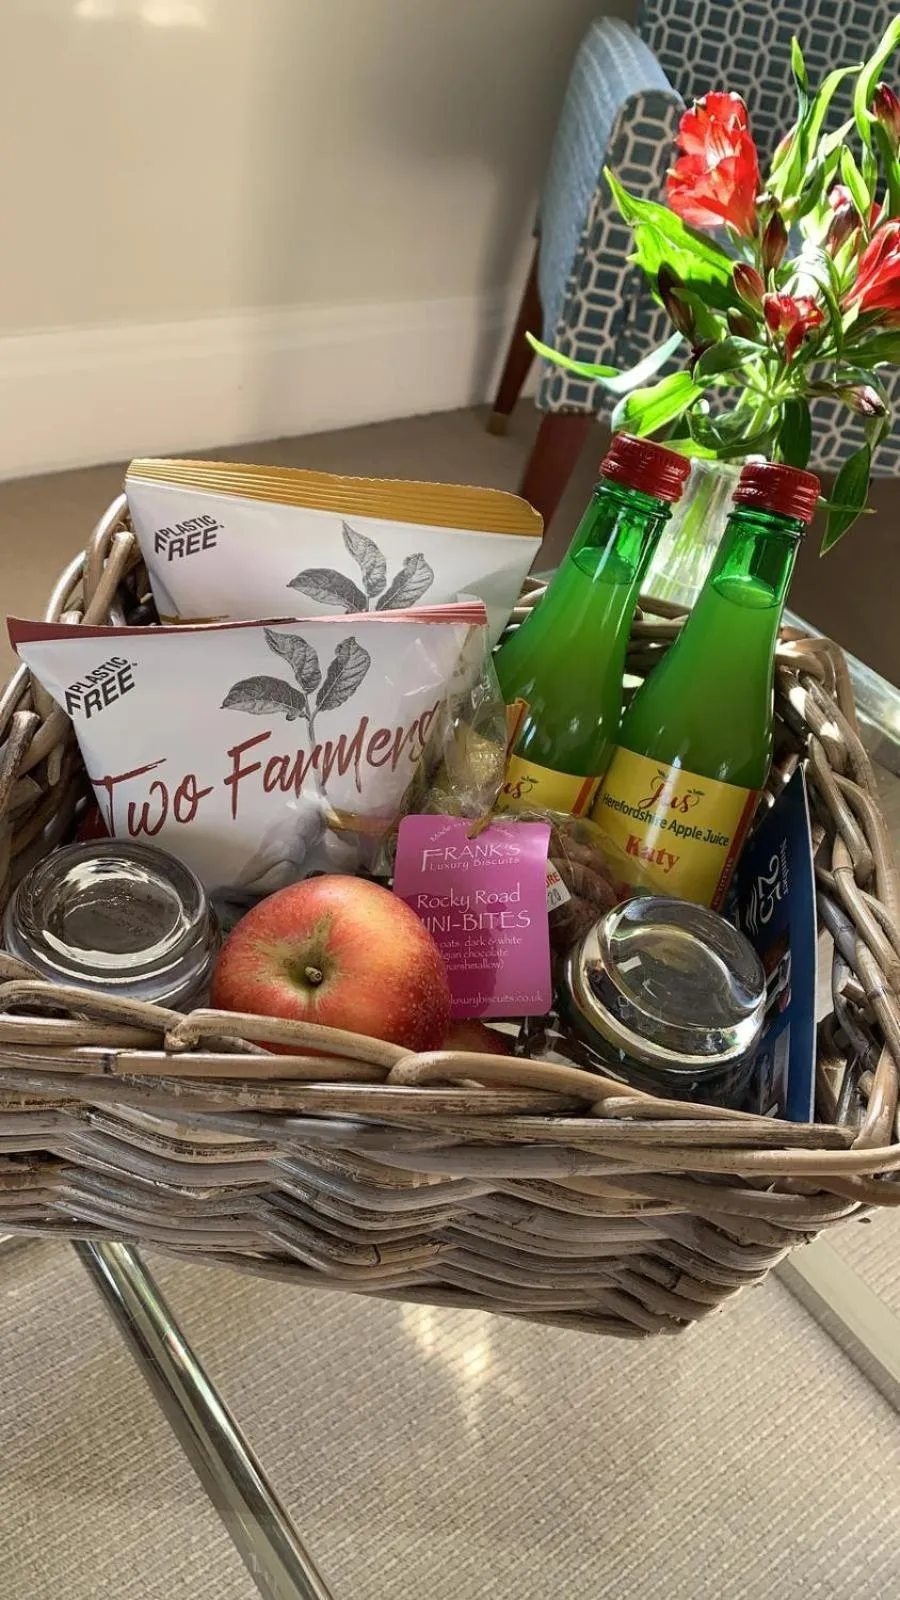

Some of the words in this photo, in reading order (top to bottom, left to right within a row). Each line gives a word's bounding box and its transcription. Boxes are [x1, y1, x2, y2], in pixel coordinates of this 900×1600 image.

[154, 525, 219, 561] FREE
[160, 514, 217, 539] PLASTIC
[64, 665, 135, 718] FREE
[71, 656, 128, 694] PLASTIC
[91, 758, 213, 838] Two
[223, 702, 440, 819] Farmers
[602, 792, 667, 828] Herefordshire
[667, 819, 703, 840] Apple
[703, 829, 731, 846] Juice
[421, 843, 521, 872] FRANK'S
[430, 861, 469, 871] Luxury
[473, 857, 521, 867] Biscuits
[625, 834, 680, 873] Katy
[417, 888, 470, 914] Rocky
[474, 881, 521, 905] Road
[497, 934, 522, 946] white
[449, 990, 544, 1006] luxurybiscuits.co.uk
